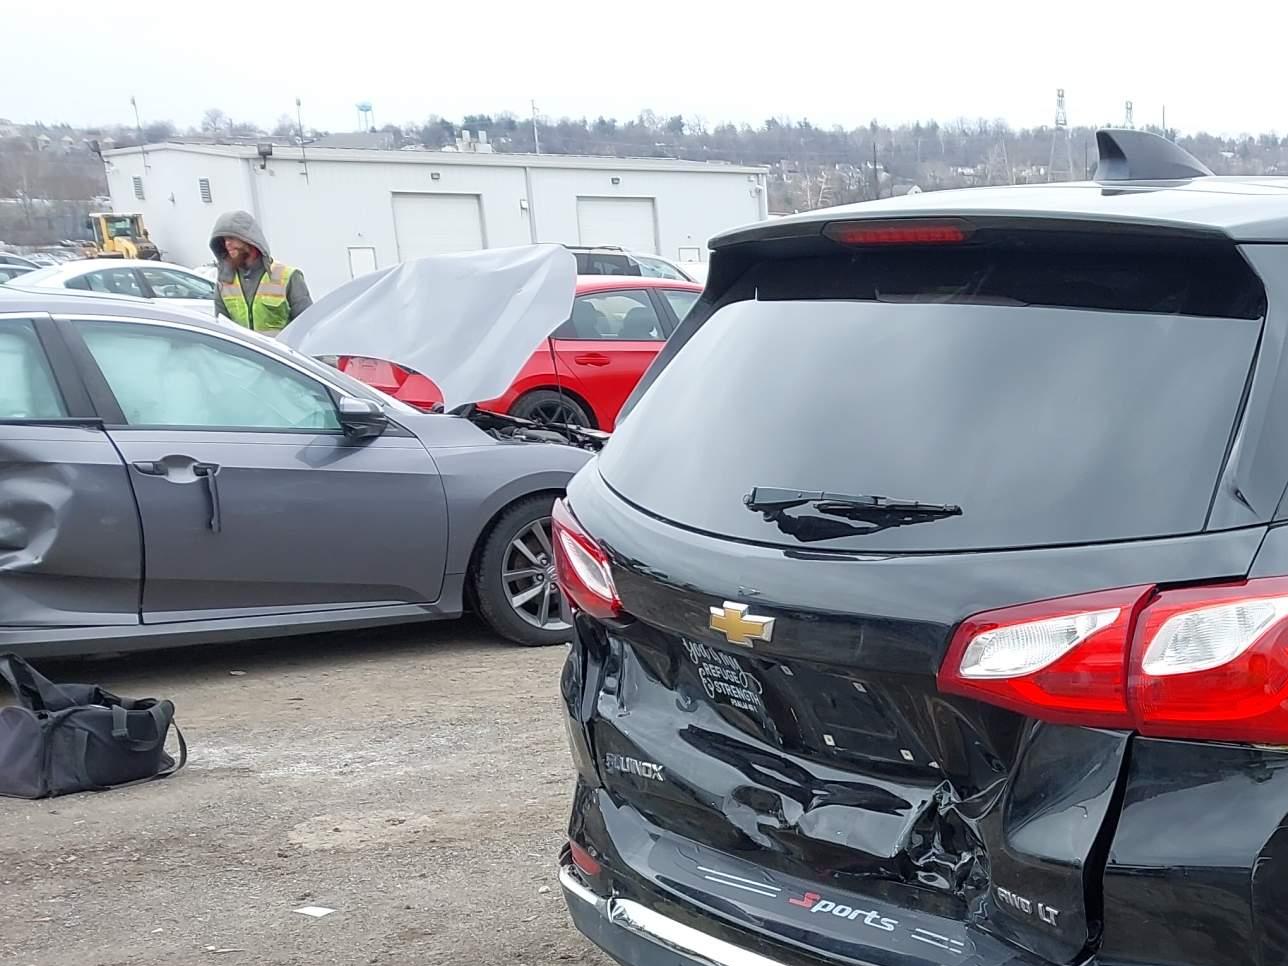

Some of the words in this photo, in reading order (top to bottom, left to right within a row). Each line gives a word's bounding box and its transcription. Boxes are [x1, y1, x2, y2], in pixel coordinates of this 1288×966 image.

[703, 661, 741, 684] REFUGE
[713, 680, 761, 706] STRENGTH
[788, 890, 900, 932] Sports
[1037, 902, 1060, 927] LT
